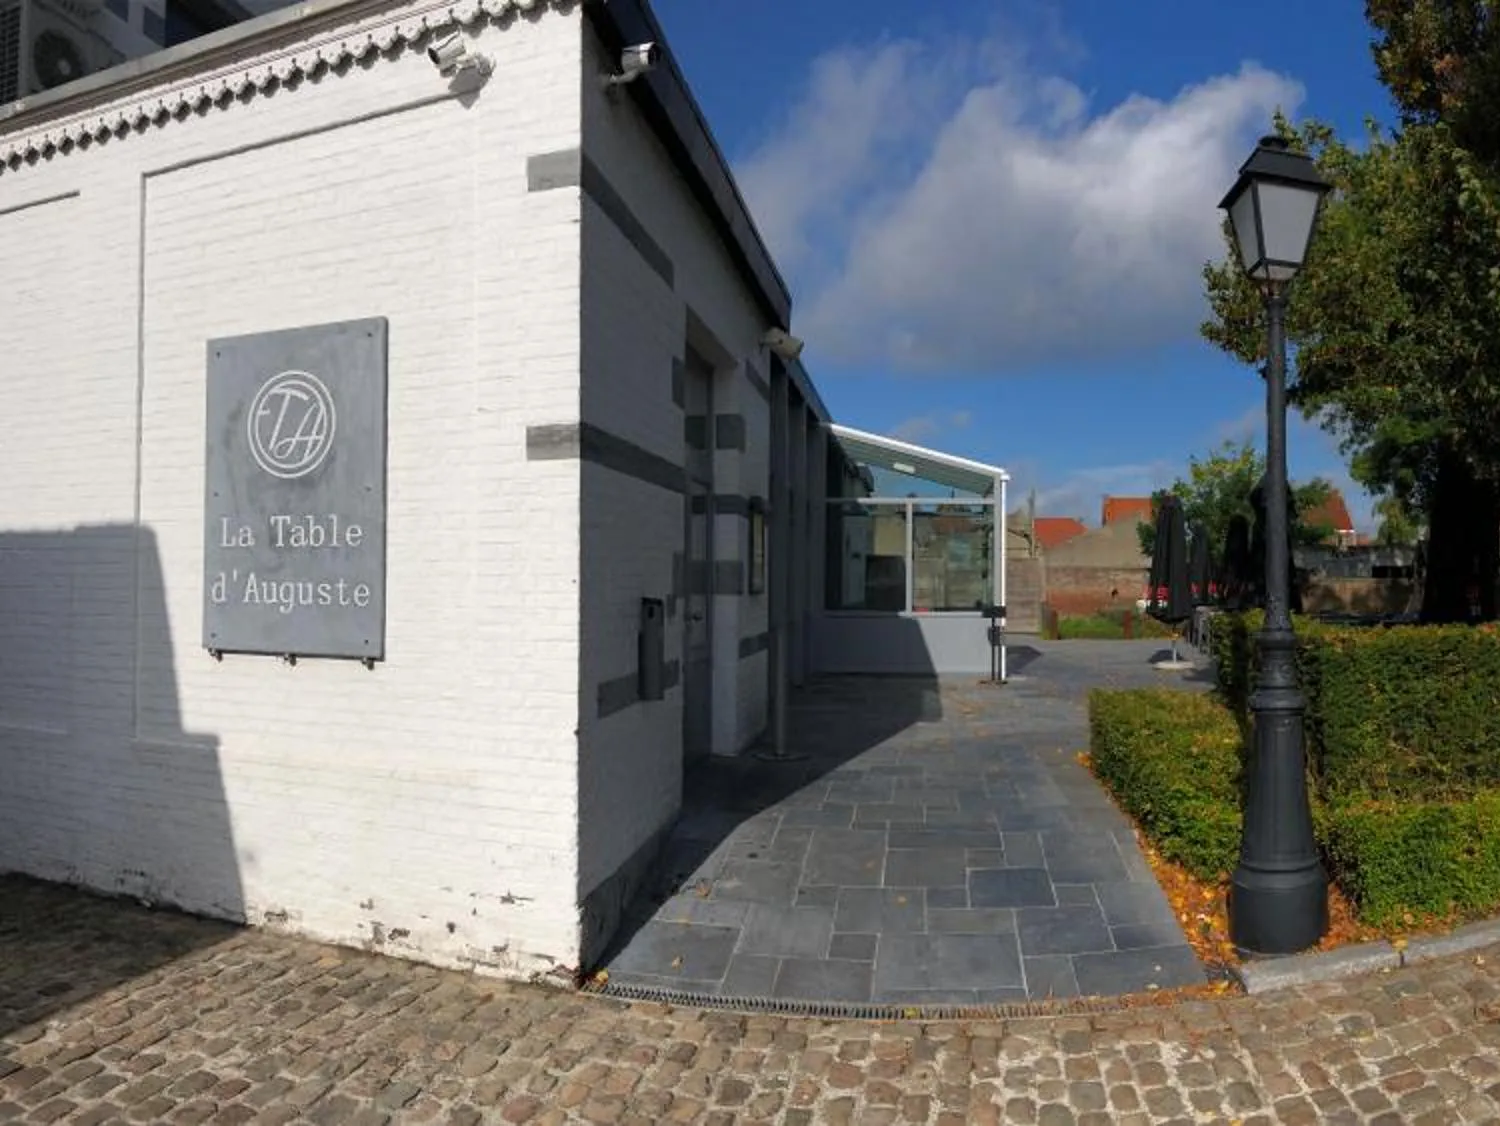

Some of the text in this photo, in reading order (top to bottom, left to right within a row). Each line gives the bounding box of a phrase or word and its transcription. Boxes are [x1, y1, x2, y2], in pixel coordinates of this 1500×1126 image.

[220, 513, 363, 547] La Table
[211, 569, 370, 614] d'Auguste
